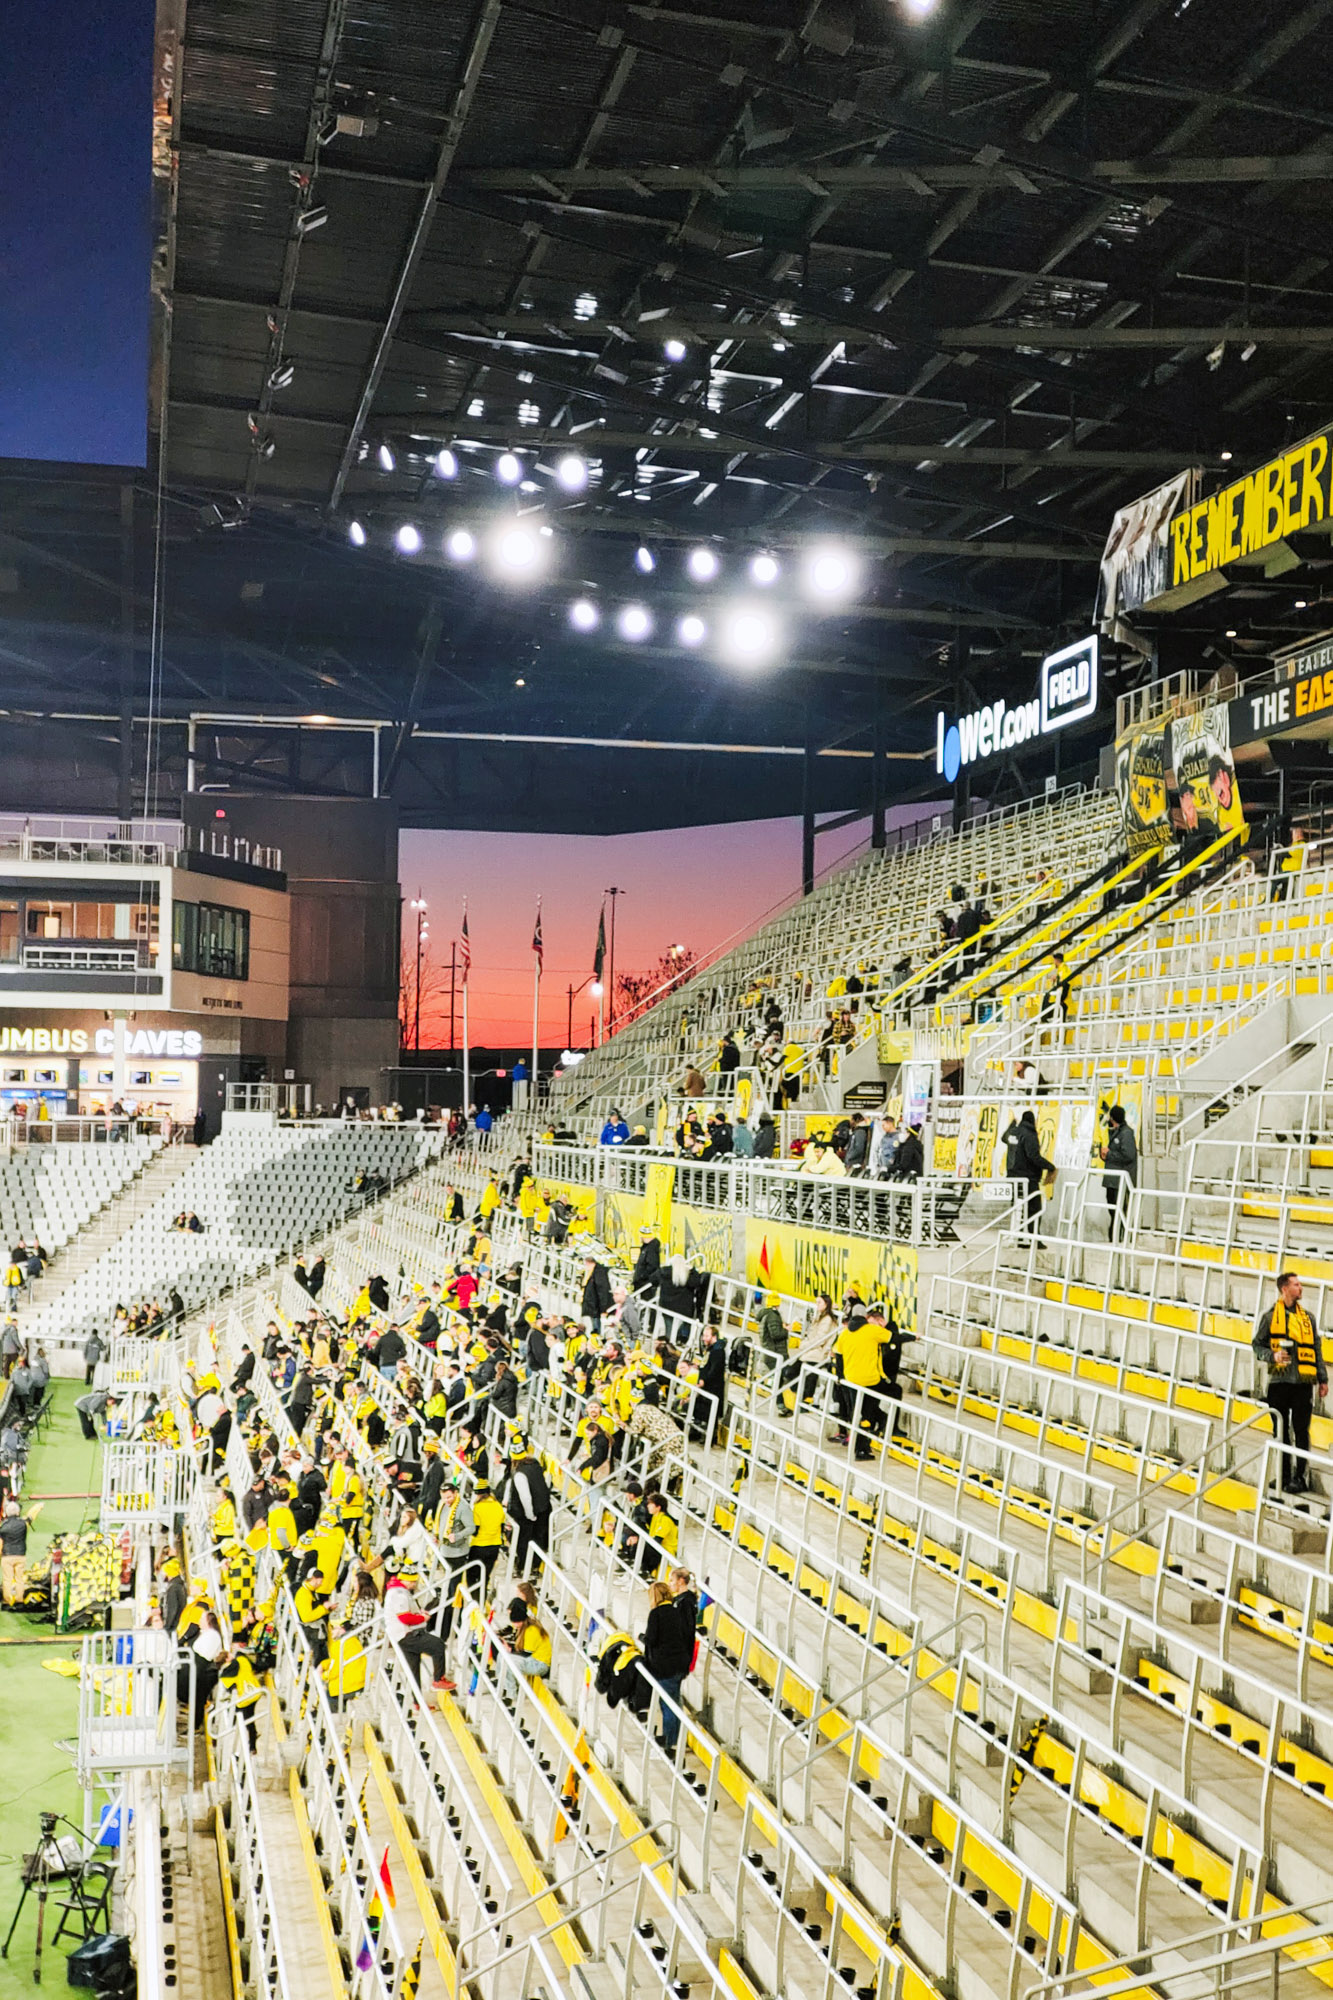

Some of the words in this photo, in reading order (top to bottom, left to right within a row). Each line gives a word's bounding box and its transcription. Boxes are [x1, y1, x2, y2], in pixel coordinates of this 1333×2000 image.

[1049, 661, 1089, 709] FIELD
[1251, 687, 1290, 731] THE
[993, 1187, 1011, 1196] 128
[794, 1238, 850, 1311] MASSIVE
